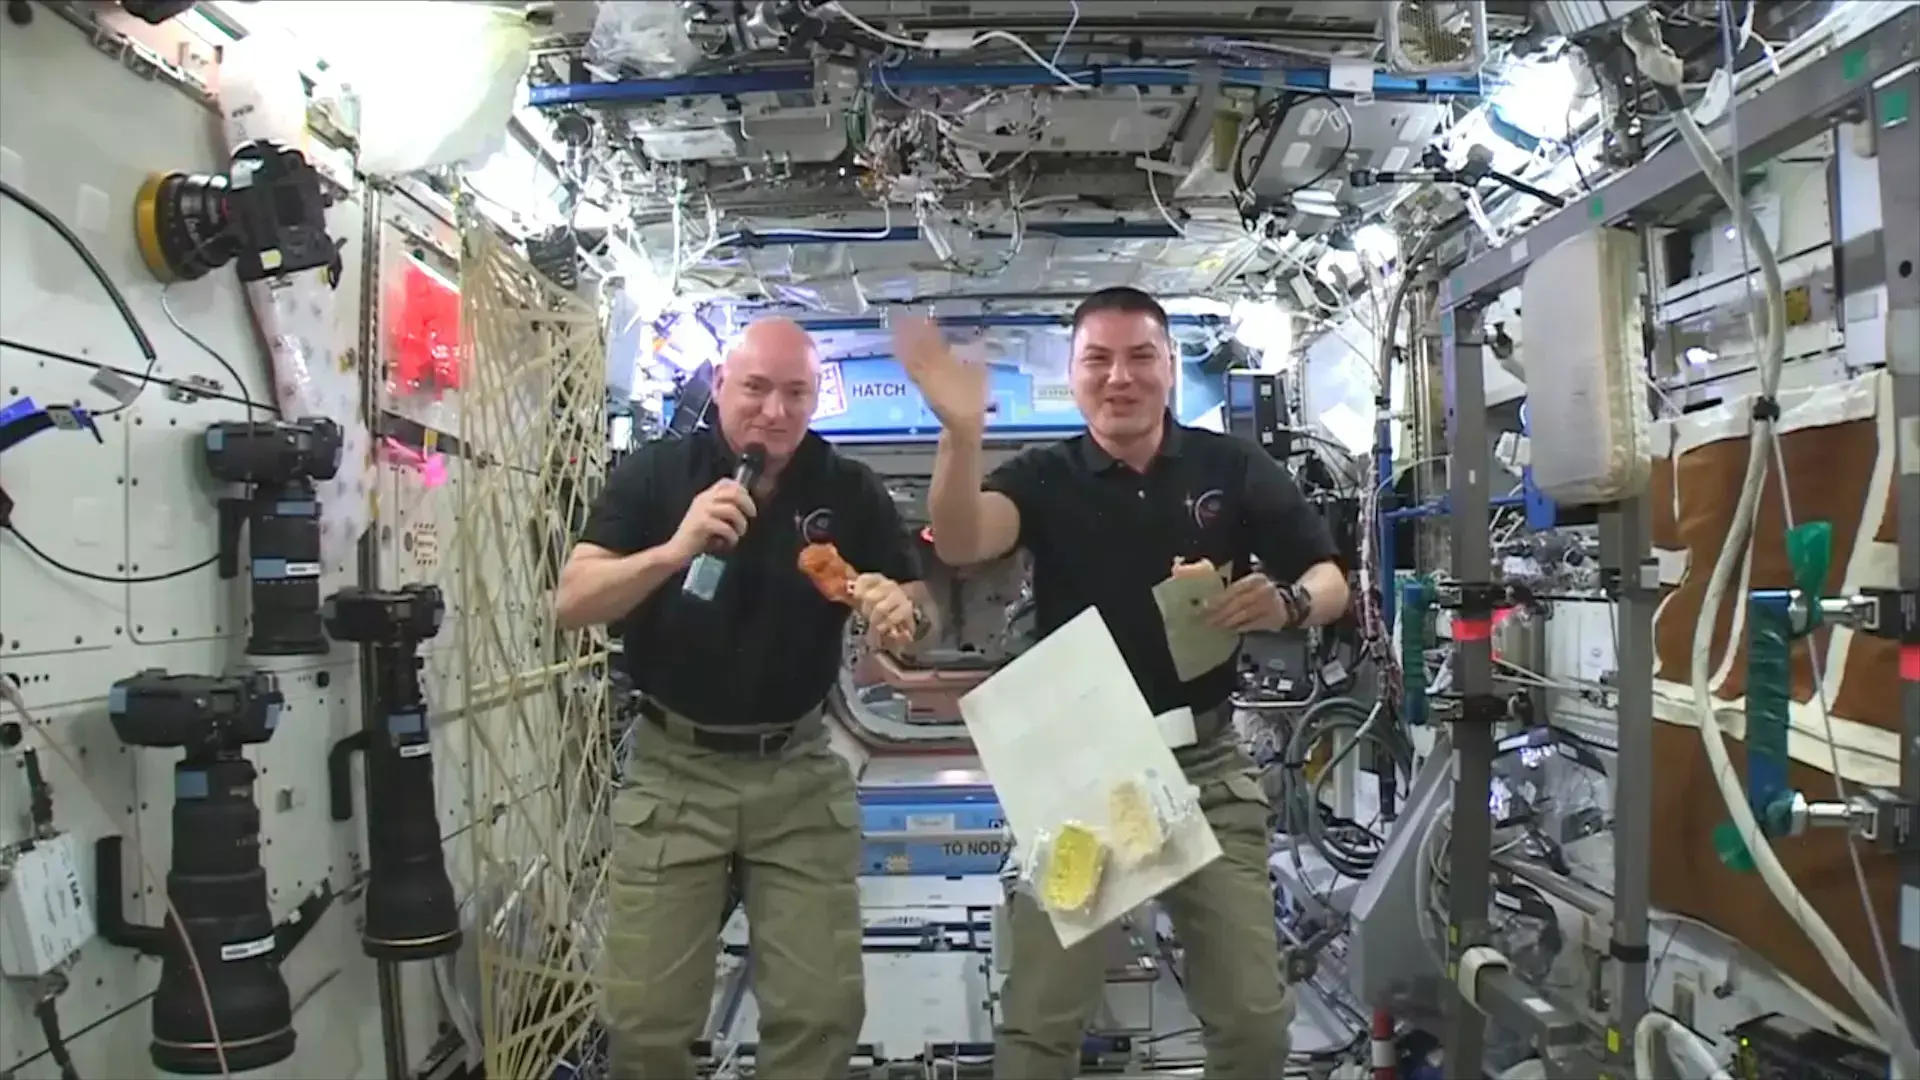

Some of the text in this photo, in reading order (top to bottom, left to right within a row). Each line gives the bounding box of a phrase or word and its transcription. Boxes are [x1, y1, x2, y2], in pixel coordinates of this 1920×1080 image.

[852, 383, 906, 397] HATCH
[943, 840, 1001, 856] TO NOD
